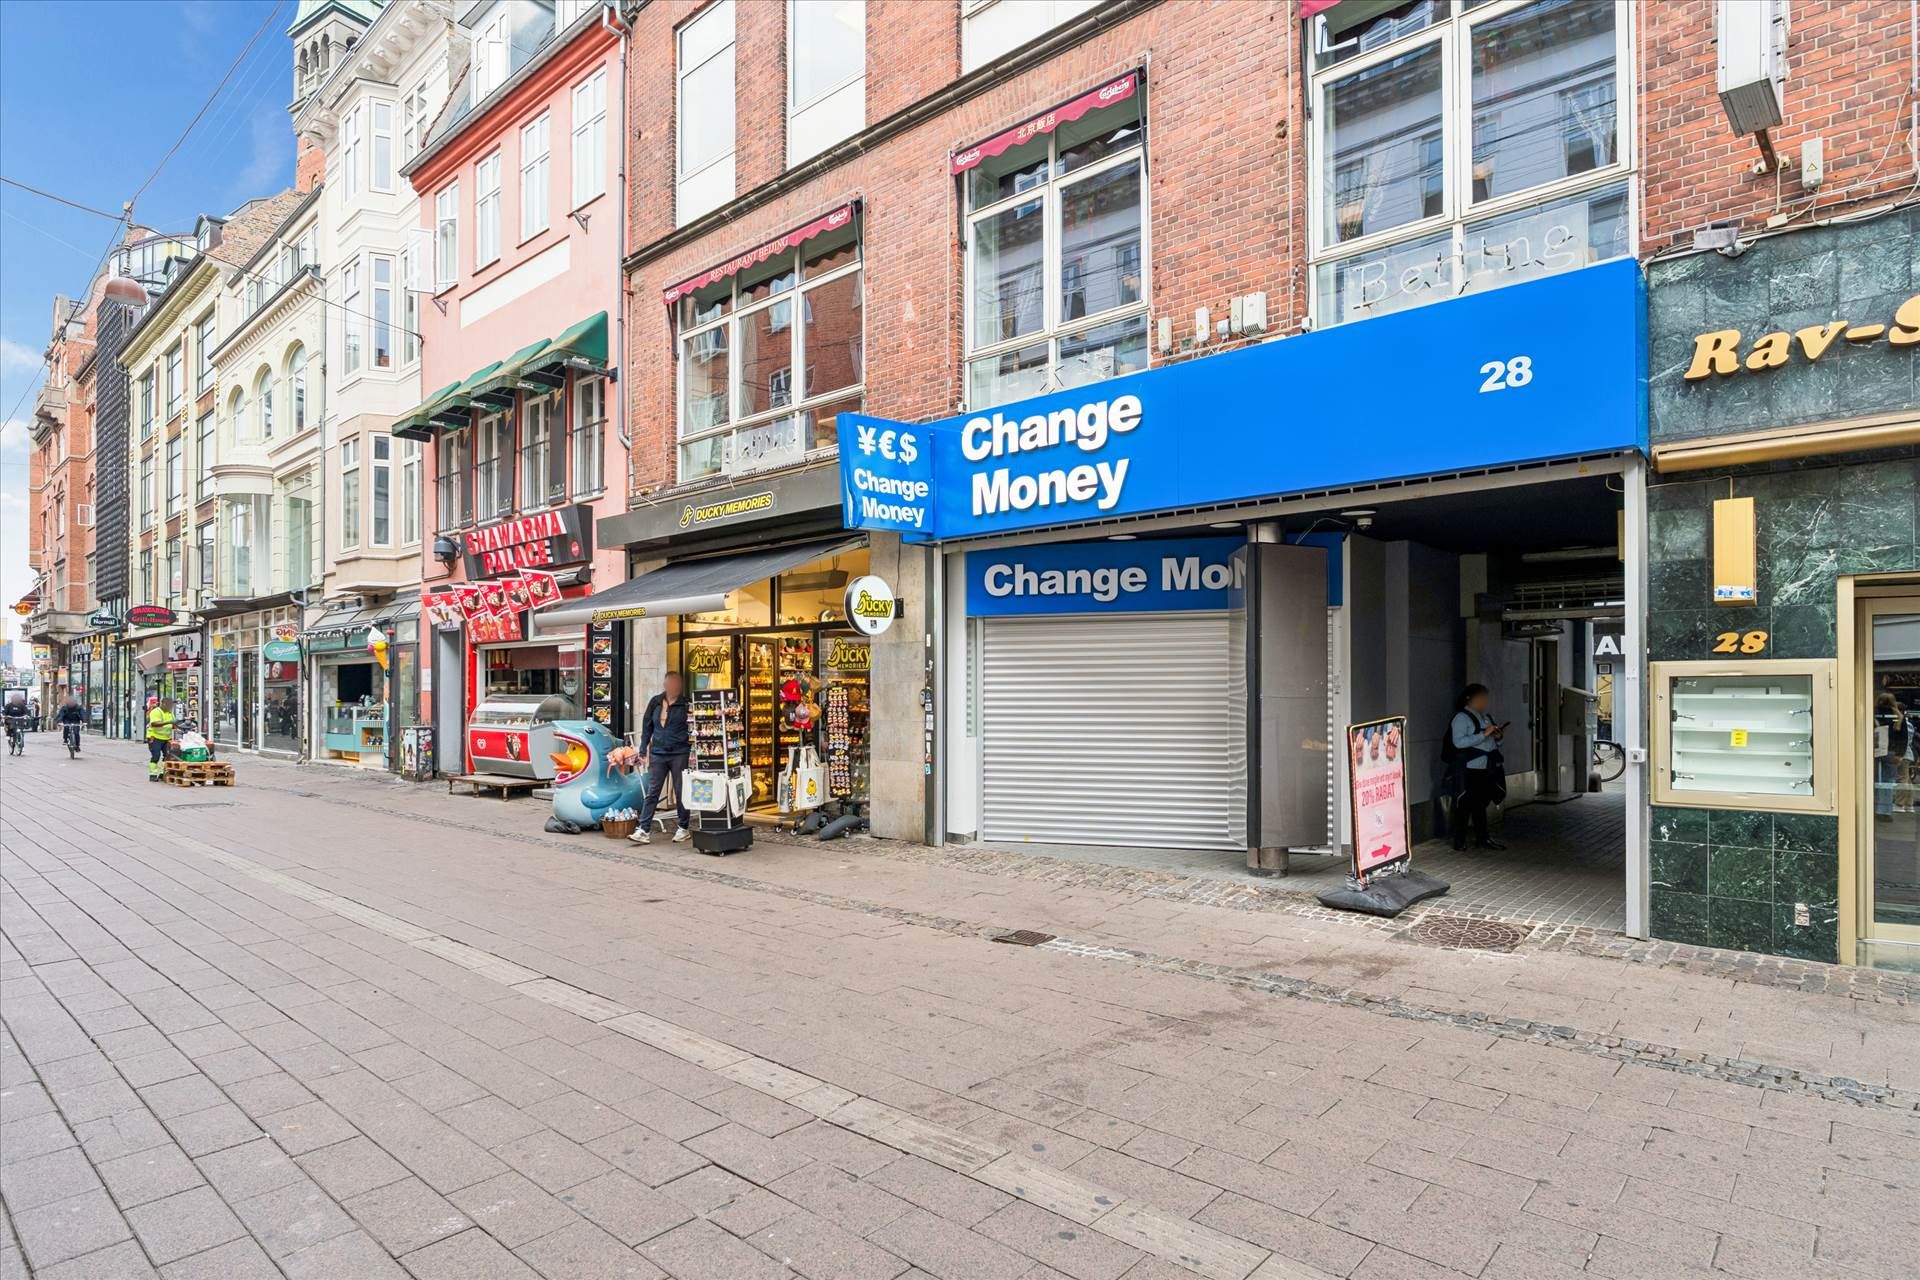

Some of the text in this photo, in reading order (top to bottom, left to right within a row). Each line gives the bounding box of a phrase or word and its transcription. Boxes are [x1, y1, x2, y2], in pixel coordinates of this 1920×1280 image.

[1099, 80, 1130, 100] Carlsberg
[710, 238, 789, 281] RESTAURANT BEIJING
[1479, 355, 1533, 393] 28
[961, 395, 1142, 462] Change
[853, 468, 929, 499] Change
[972, 458, 1130, 517] Money
[696, 493, 773, 522] DUCKY MEMORIES
[862, 496, 925, 527] Money
[465, 511, 567, 555] SHAWARMA
[483, 540, 554, 575] PALACE
[984, 563, 1147, 602] Change
[1713, 630, 1768, 655] 28
[1361, 782, 1396, 807] 20% RABAT
